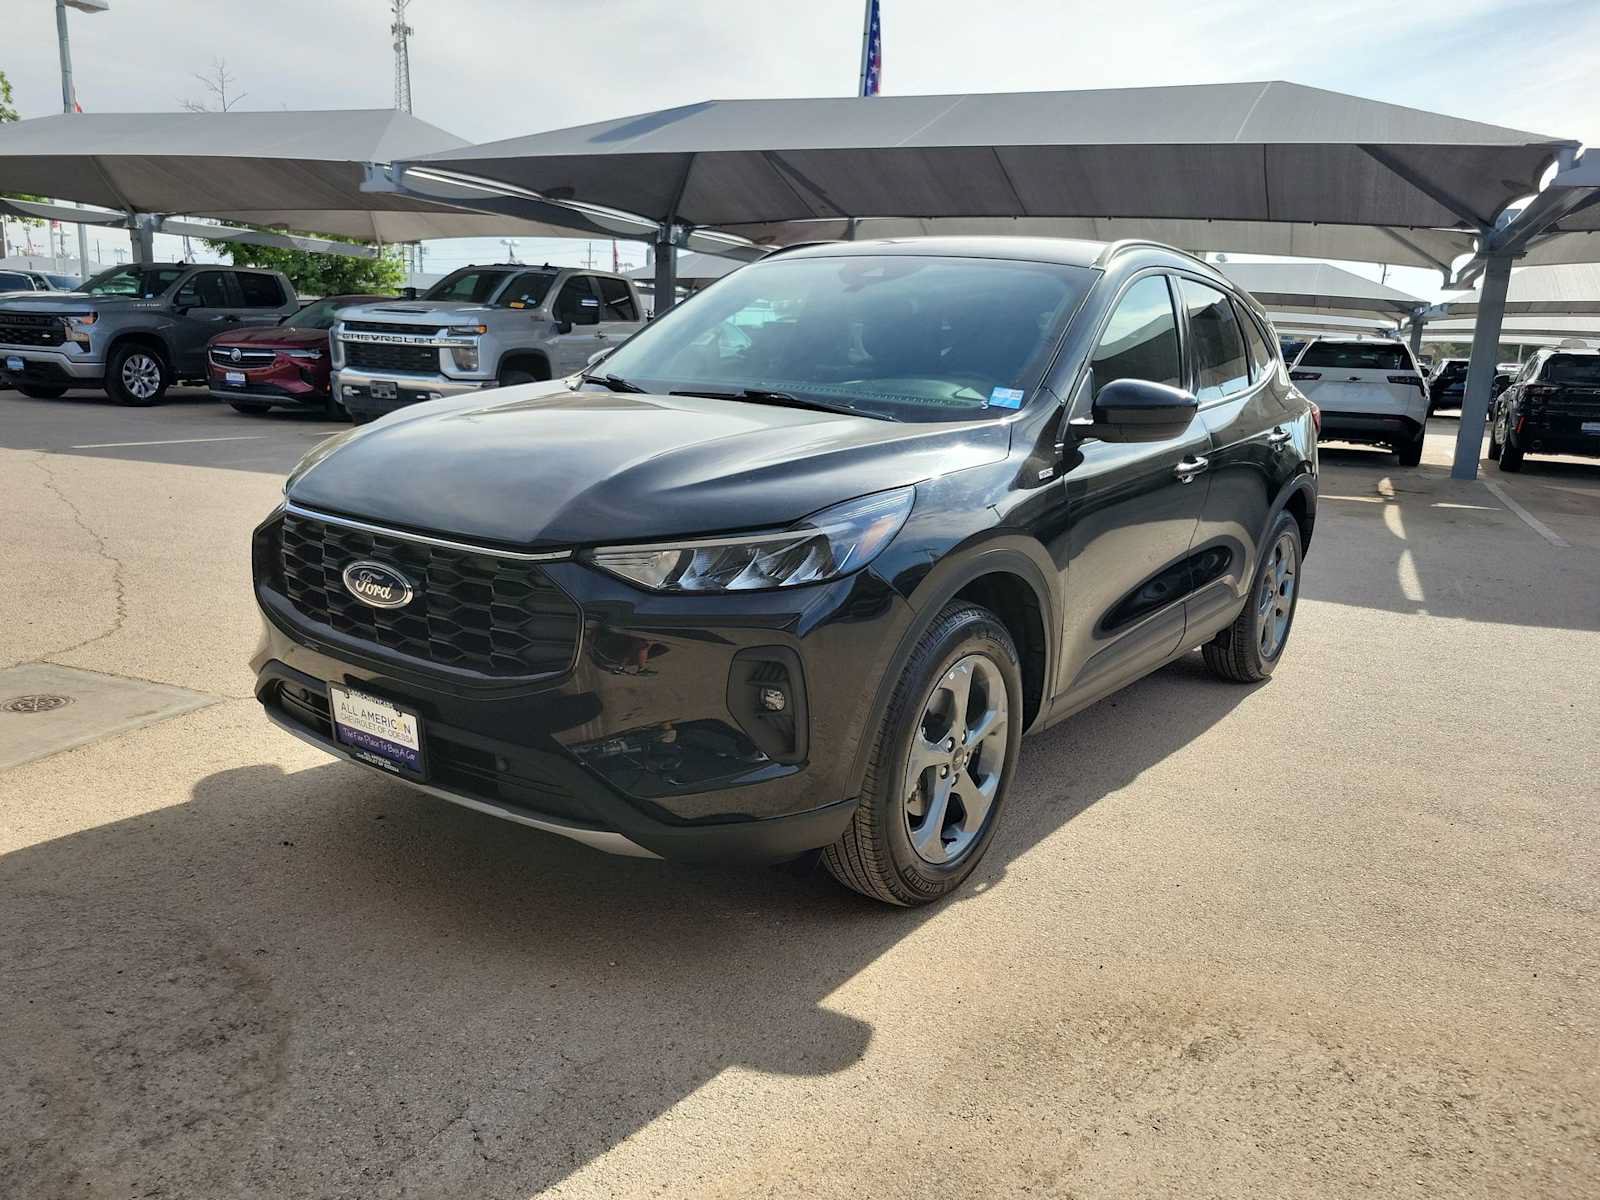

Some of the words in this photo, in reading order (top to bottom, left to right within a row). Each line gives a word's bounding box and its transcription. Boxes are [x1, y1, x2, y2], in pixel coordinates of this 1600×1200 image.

[342, 333, 435, 344] CHEVROLET
[356, 570, 393, 599] Ford
[341, 703, 359, 716] ALL
[361, 709, 411, 733] AMERICN
